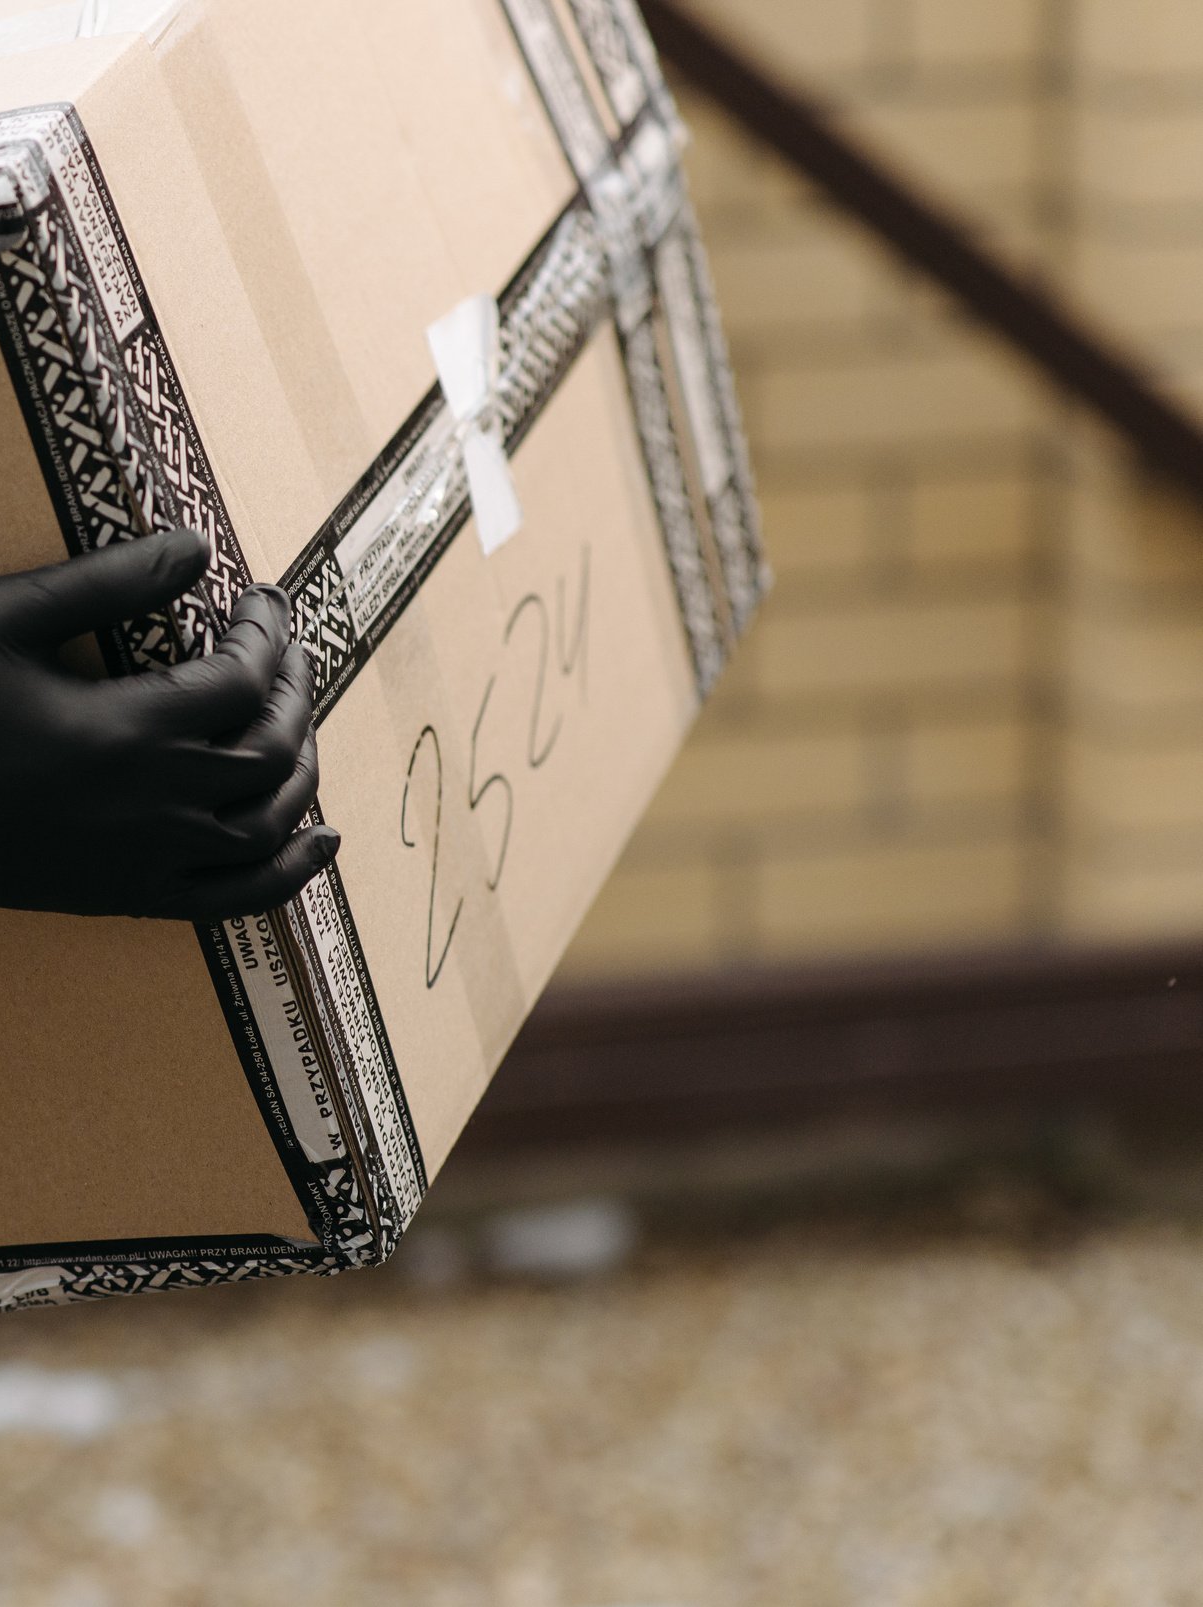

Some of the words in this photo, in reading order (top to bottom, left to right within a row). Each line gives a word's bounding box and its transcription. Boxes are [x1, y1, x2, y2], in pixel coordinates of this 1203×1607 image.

[78, 168, 111, 238] SPISAĆ
[100, 187, 118, 224] 94-250
[58, 163, 114, 295] PRZYPADKU
[113, 224, 124, 240] SA
[79, 193, 133, 320] ZAKLEJENIA
[119, 240, 139, 281] REDAN
[105, 239, 140, 313] NALEŻY
[0, 298, 12, 311] O
[152, 331, 176, 383] KONTAKT
[171, 384, 180, 395] O
[192, 440, 212, 482] PACZKI
[61, 483, 83, 522] BRAKU
[207, 481, 242, 561] IDENTYFIKACJI
[75, 523, 94, 553] PRZY
[303, 544, 329, 575] KONTAKT
[346, 577, 358, 595] W
[354, 585, 388, 632] NALEŻY
[335, 655, 360, 686] KONTAKT
[401, 541, 593, 990] 2524
[343, 914, 360, 957] 6177103
[216, 943, 232, 970] 10/14
[355, 954, 364, 970] 42
[224, 970, 245, 1007] Żniwna
[331, 940, 367, 1043] FIRMOWEJ
[351, 982, 363, 1004] W
[236, 1007, 250, 1022] ul.
[324, 946, 372, 1092] USZKODZENIA
[370, 1007, 383, 1036] 10/14
[252, 1049, 271, 1082] 94-250
[282, 999, 333, 1119] PRZYPADKU
[356, 1000, 391, 1102] PROTOKÓŁ
[378, 1033, 394, 1074] Żniwna
[263, 1081, 276, 1098] SA
[365, 1052, 388, 1118] TAŚMY
[389, 1068, 398, 1086] ul.
[327, 1129, 344, 1151] W
[385, 1097, 410, 1167] SPISAĆ
[402, 1110, 415, 1146] 94-250
[410, 1142, 419, 1162] SA
[149, 1248, 198, 1259] UWAGA!!!
[199, 1246, 227, 1258] PRZY
[230, 1245, 268, 1257] BRAKU
